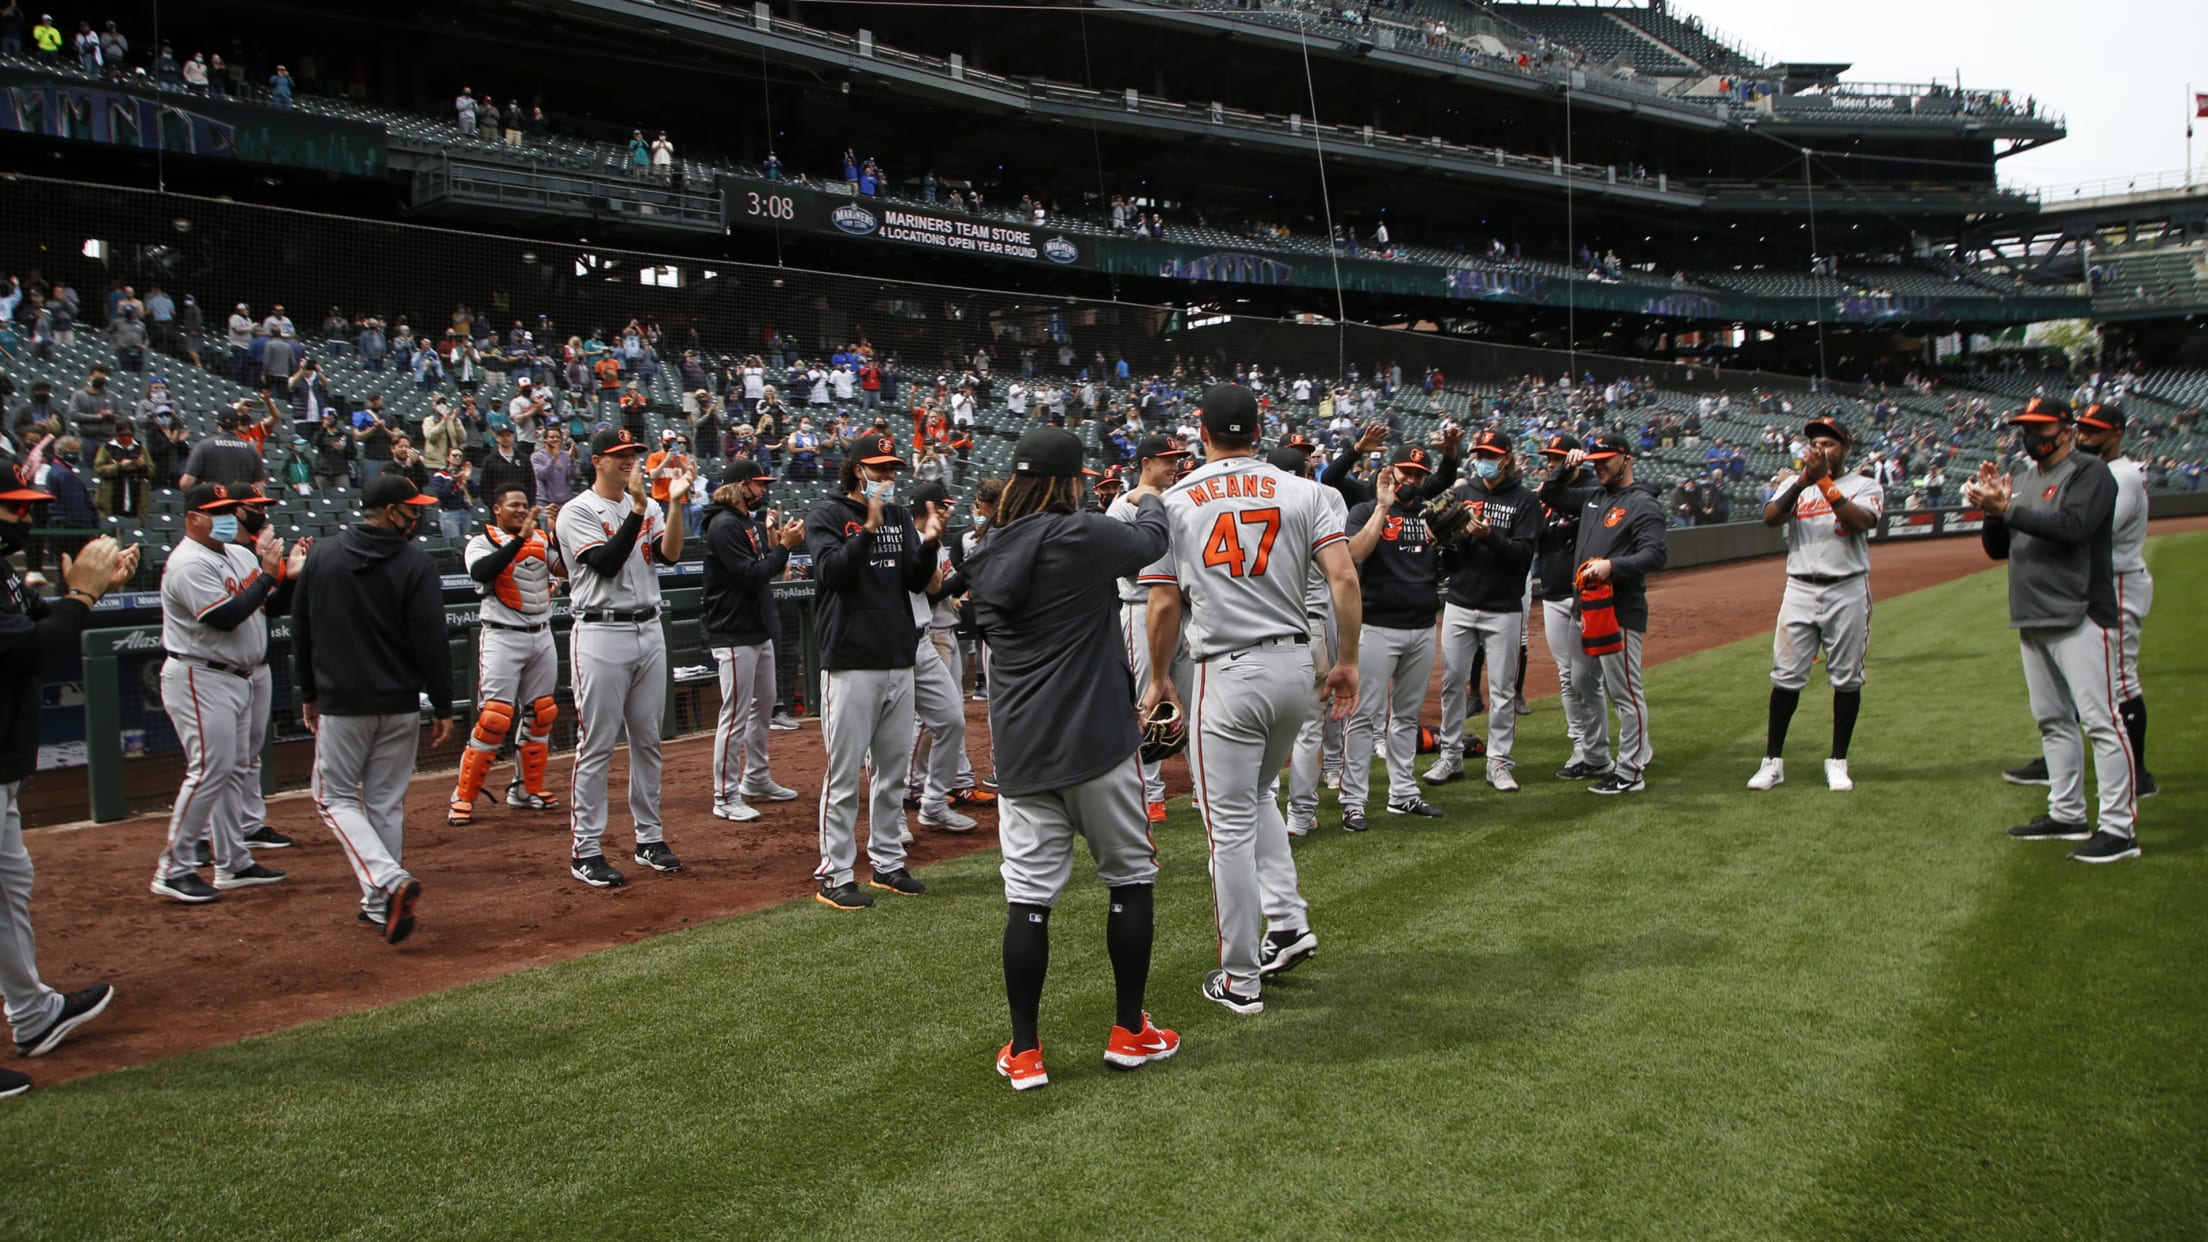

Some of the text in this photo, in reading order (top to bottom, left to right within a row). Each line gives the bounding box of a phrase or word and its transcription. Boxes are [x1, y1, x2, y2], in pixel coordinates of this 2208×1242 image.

[1869, 96, 1895, 108] Deck
[748, 192, 794, 220] 3:08
[878, 226, 886, 238] 4
[888, 228, 946, 246] LOCATIONS
[948, 237, 975, 250] OPEN
[977, 241, 1003, 253] YEAR
[1005, 246, 1037, 259] ROUND
[885, 211, 952, 233] MARINERS
[955, 222, 989, 239] TEAM
[992, 228, 1031, 245] STORE
[214, 439, 248, 449] SECURITY
[1187, 474, 1277, 507] MEANS
[1203, 507, 1281, 577] 47
